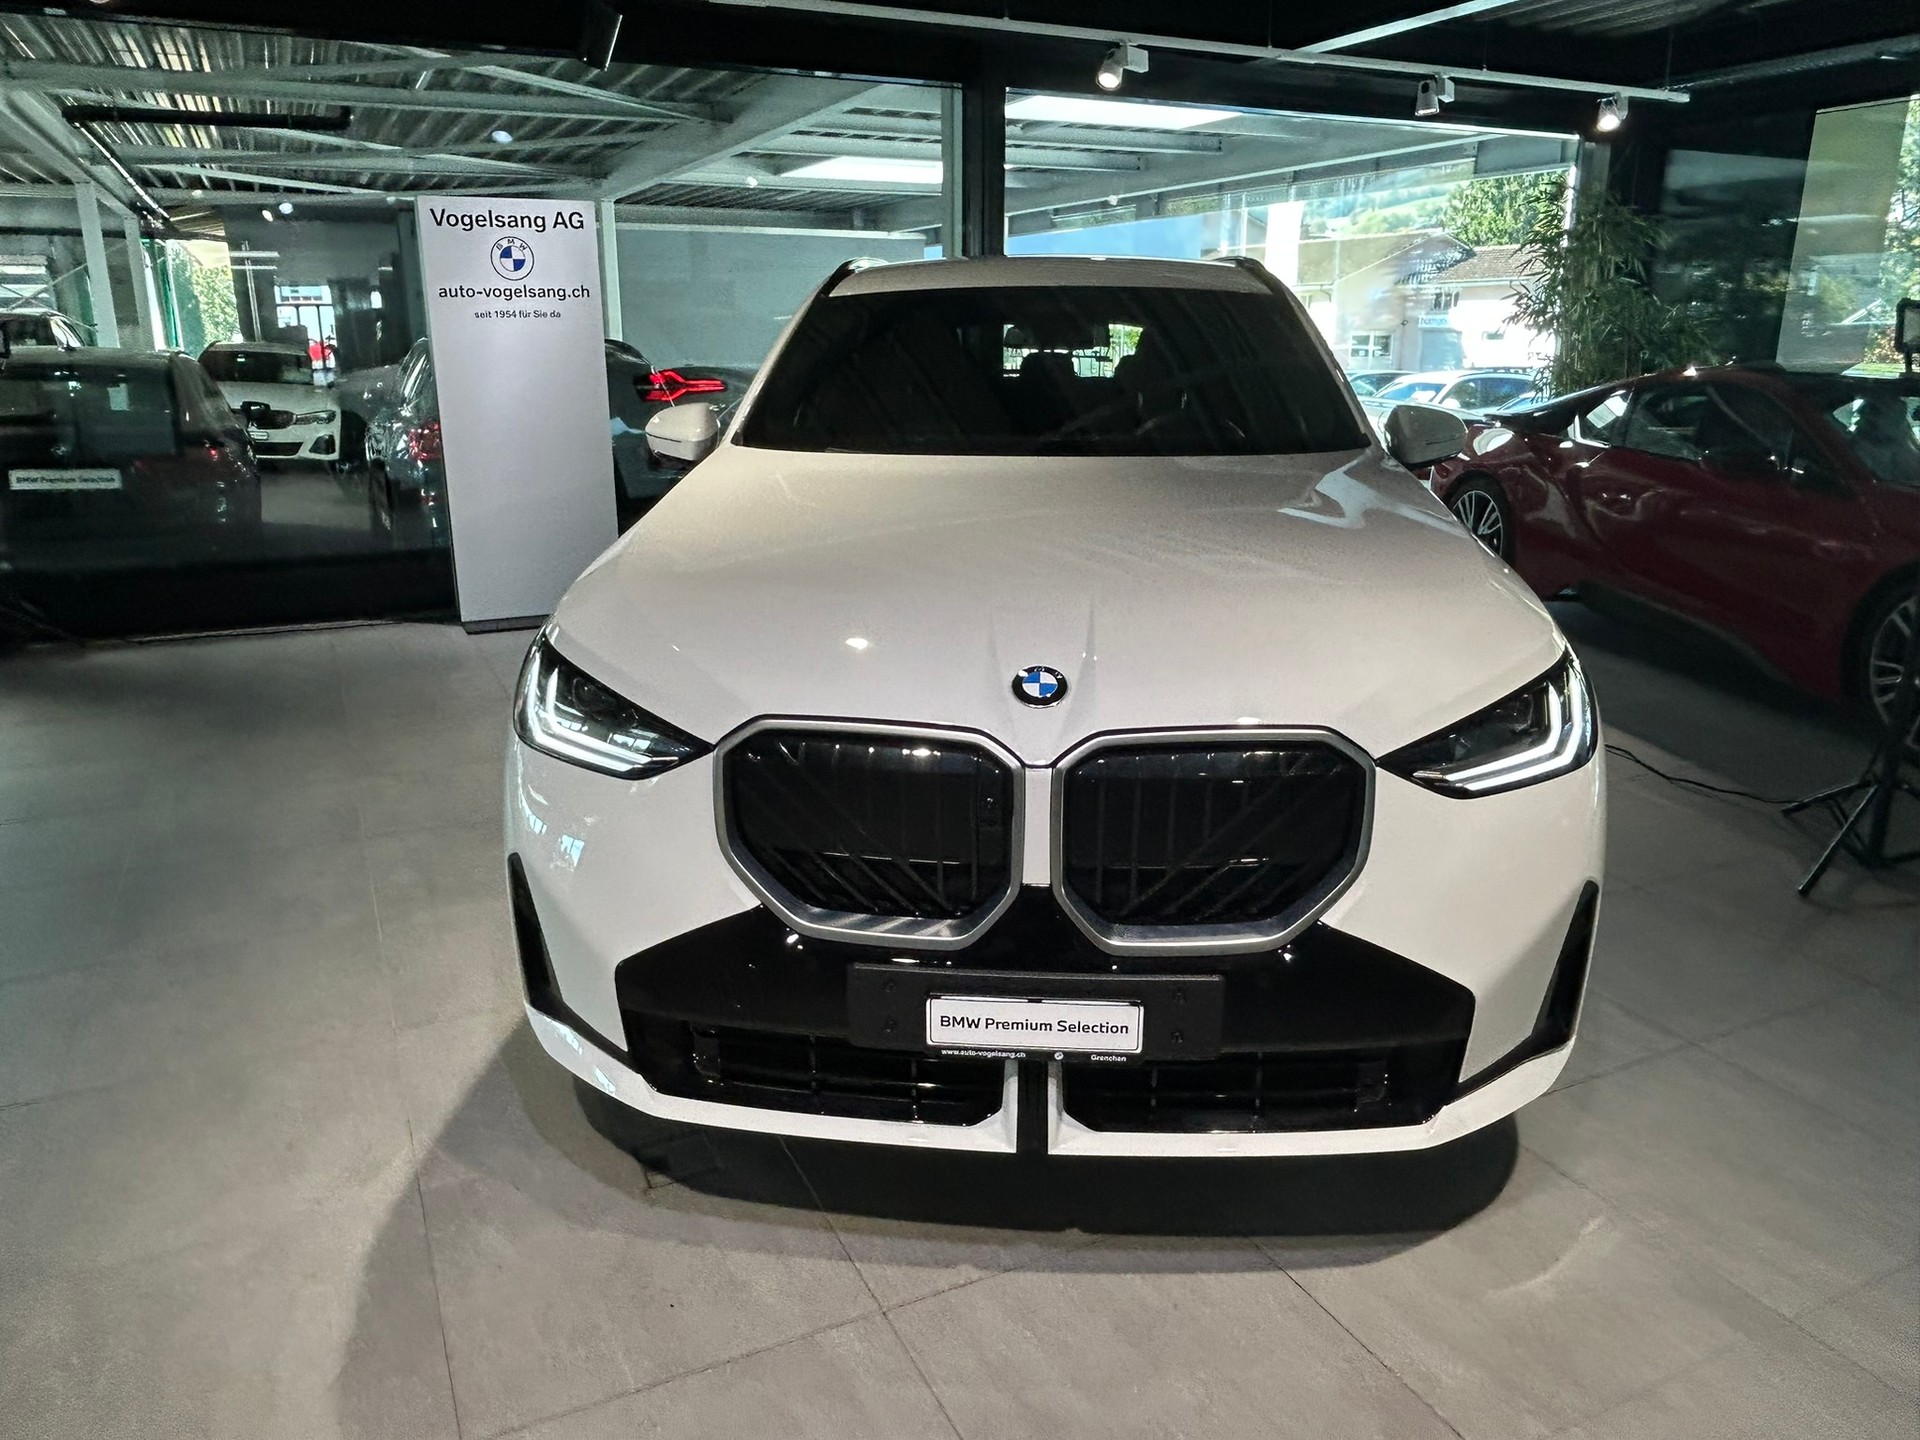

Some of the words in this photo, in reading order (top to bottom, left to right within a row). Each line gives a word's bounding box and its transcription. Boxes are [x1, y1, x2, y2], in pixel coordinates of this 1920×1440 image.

[429, 208, 546, 233] Vogelsang
[552, 211, 584, 230] AG
[495, 238, 528, 251] BMW
[438, 285, 591, 301] auto-vogelsang.ch
[474, 309, 492, 319] seit
[495, 310, 517, 318] 1954
[519, 309, 531, 318] für
[533, 309, 548, 318] Sie
[550, 310, 561, 318] da
[940, 1015, 981, 1029] BMW
[985, 1017, 1053, 1032] Premium
[1057, 1020, 1129, 1034] Selection
[941, 1049, 1026, 1059] www.auto-vogelsang.ch
